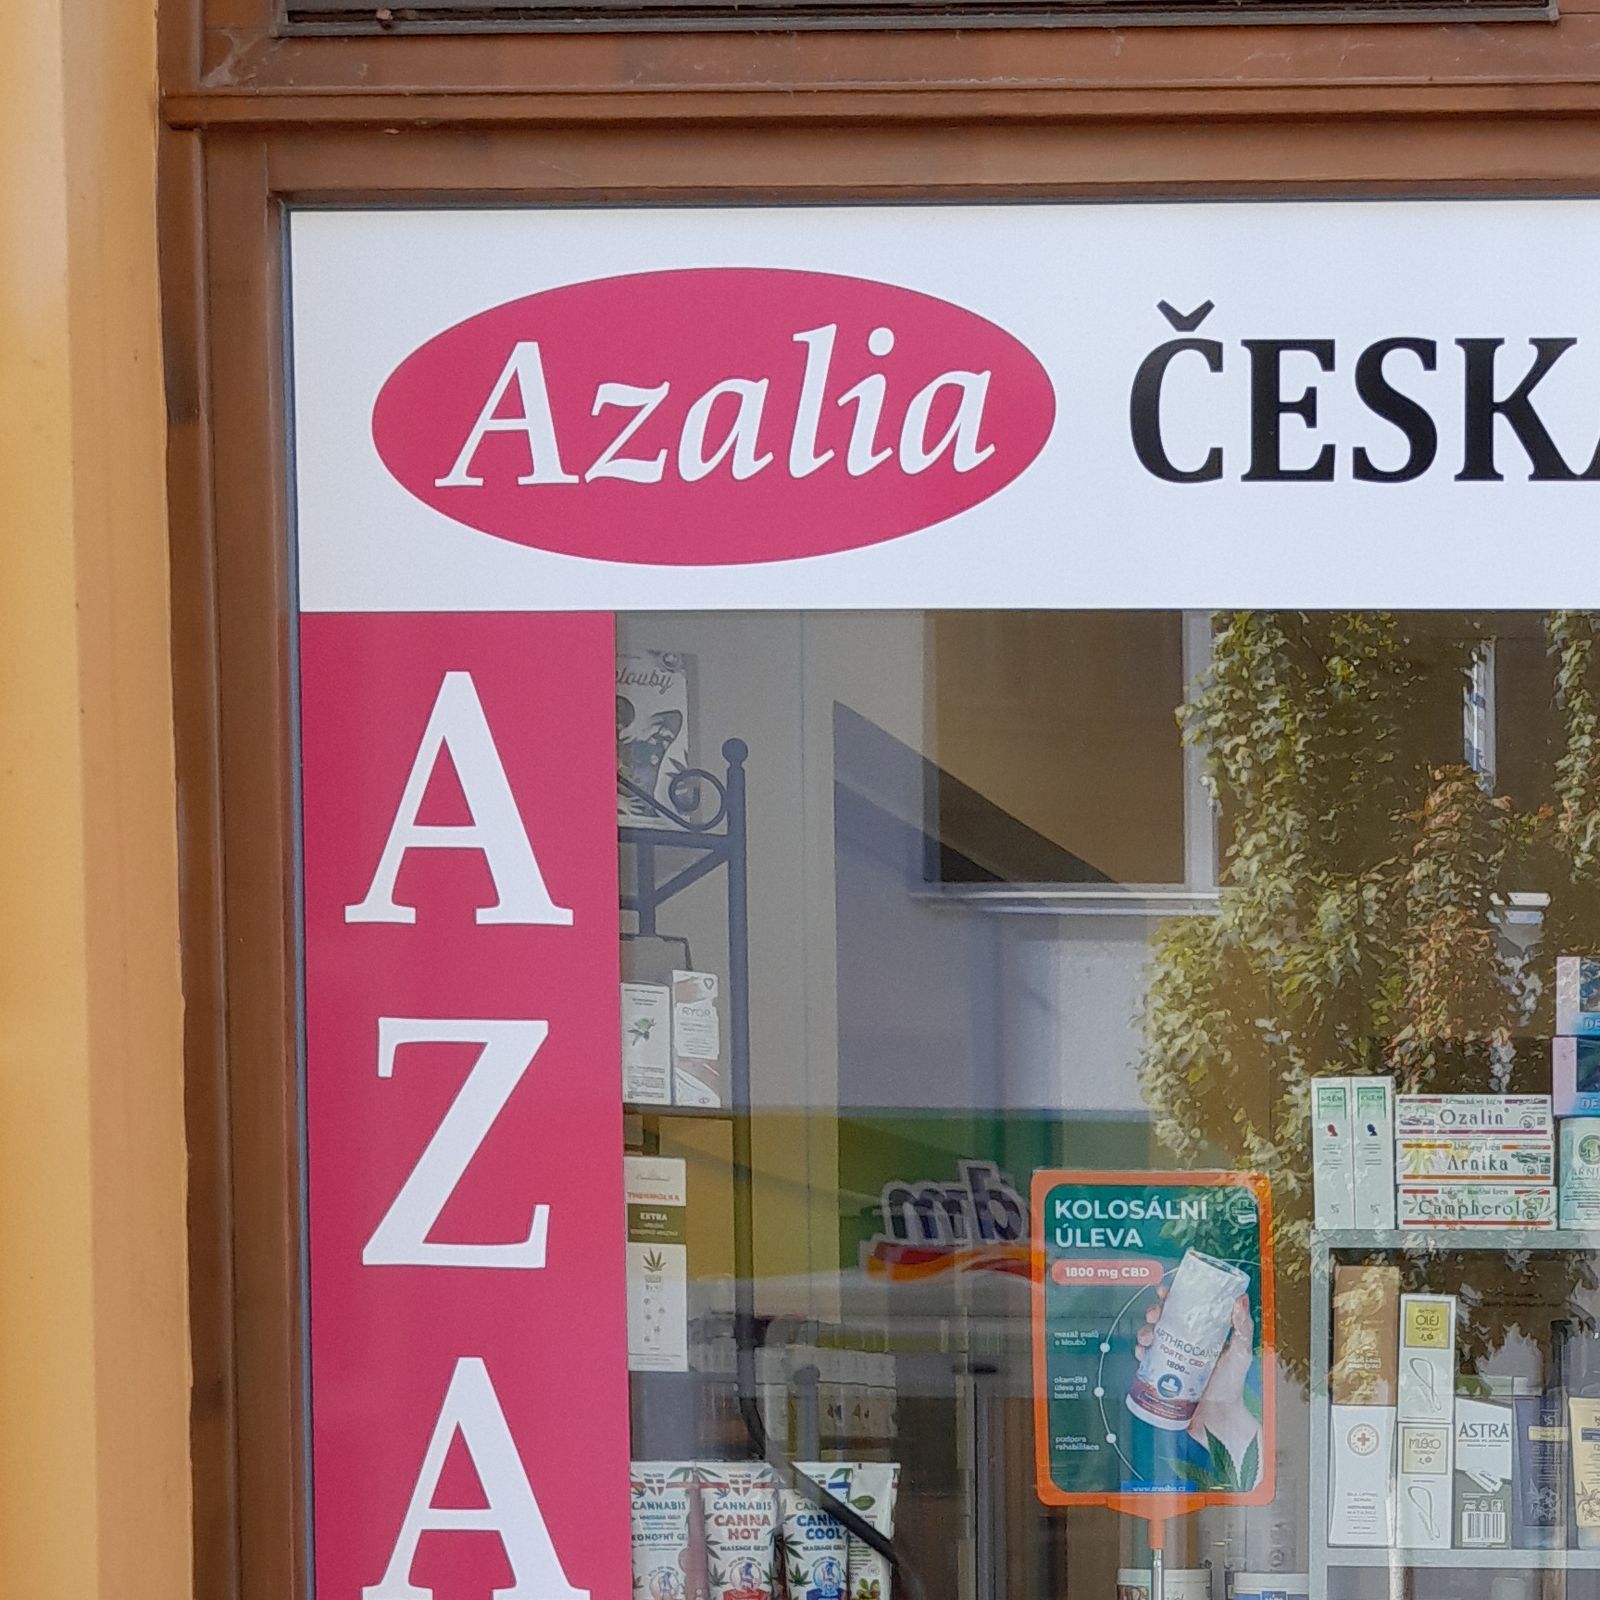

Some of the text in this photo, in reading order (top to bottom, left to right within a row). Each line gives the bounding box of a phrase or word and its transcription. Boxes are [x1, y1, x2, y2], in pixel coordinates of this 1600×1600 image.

[432, 322, 997, 489] Azalia
[1440, 1108, 1504, 1126] Ozalin
[1447, 1153, 1508, 1172] Arnika
[1054, 1196, 1208, 1222] KOLOSÁLNÍ
[1054, 1226, 1143, 1249] ÚLEVA
[1064, 1266, 1150, 1281] 1800 mg CBD
[1459, 1422, 1508, 1439] ASTRA
[632, 1501, 686, 1511] CANNABIS
[713, 1501, 773, 1512] CANNABIS
[714, 1515, 771, 1527] CANNA
[728, 1529, 760, 1540] HOT
[806, 1529, 843, 1540] COOL
